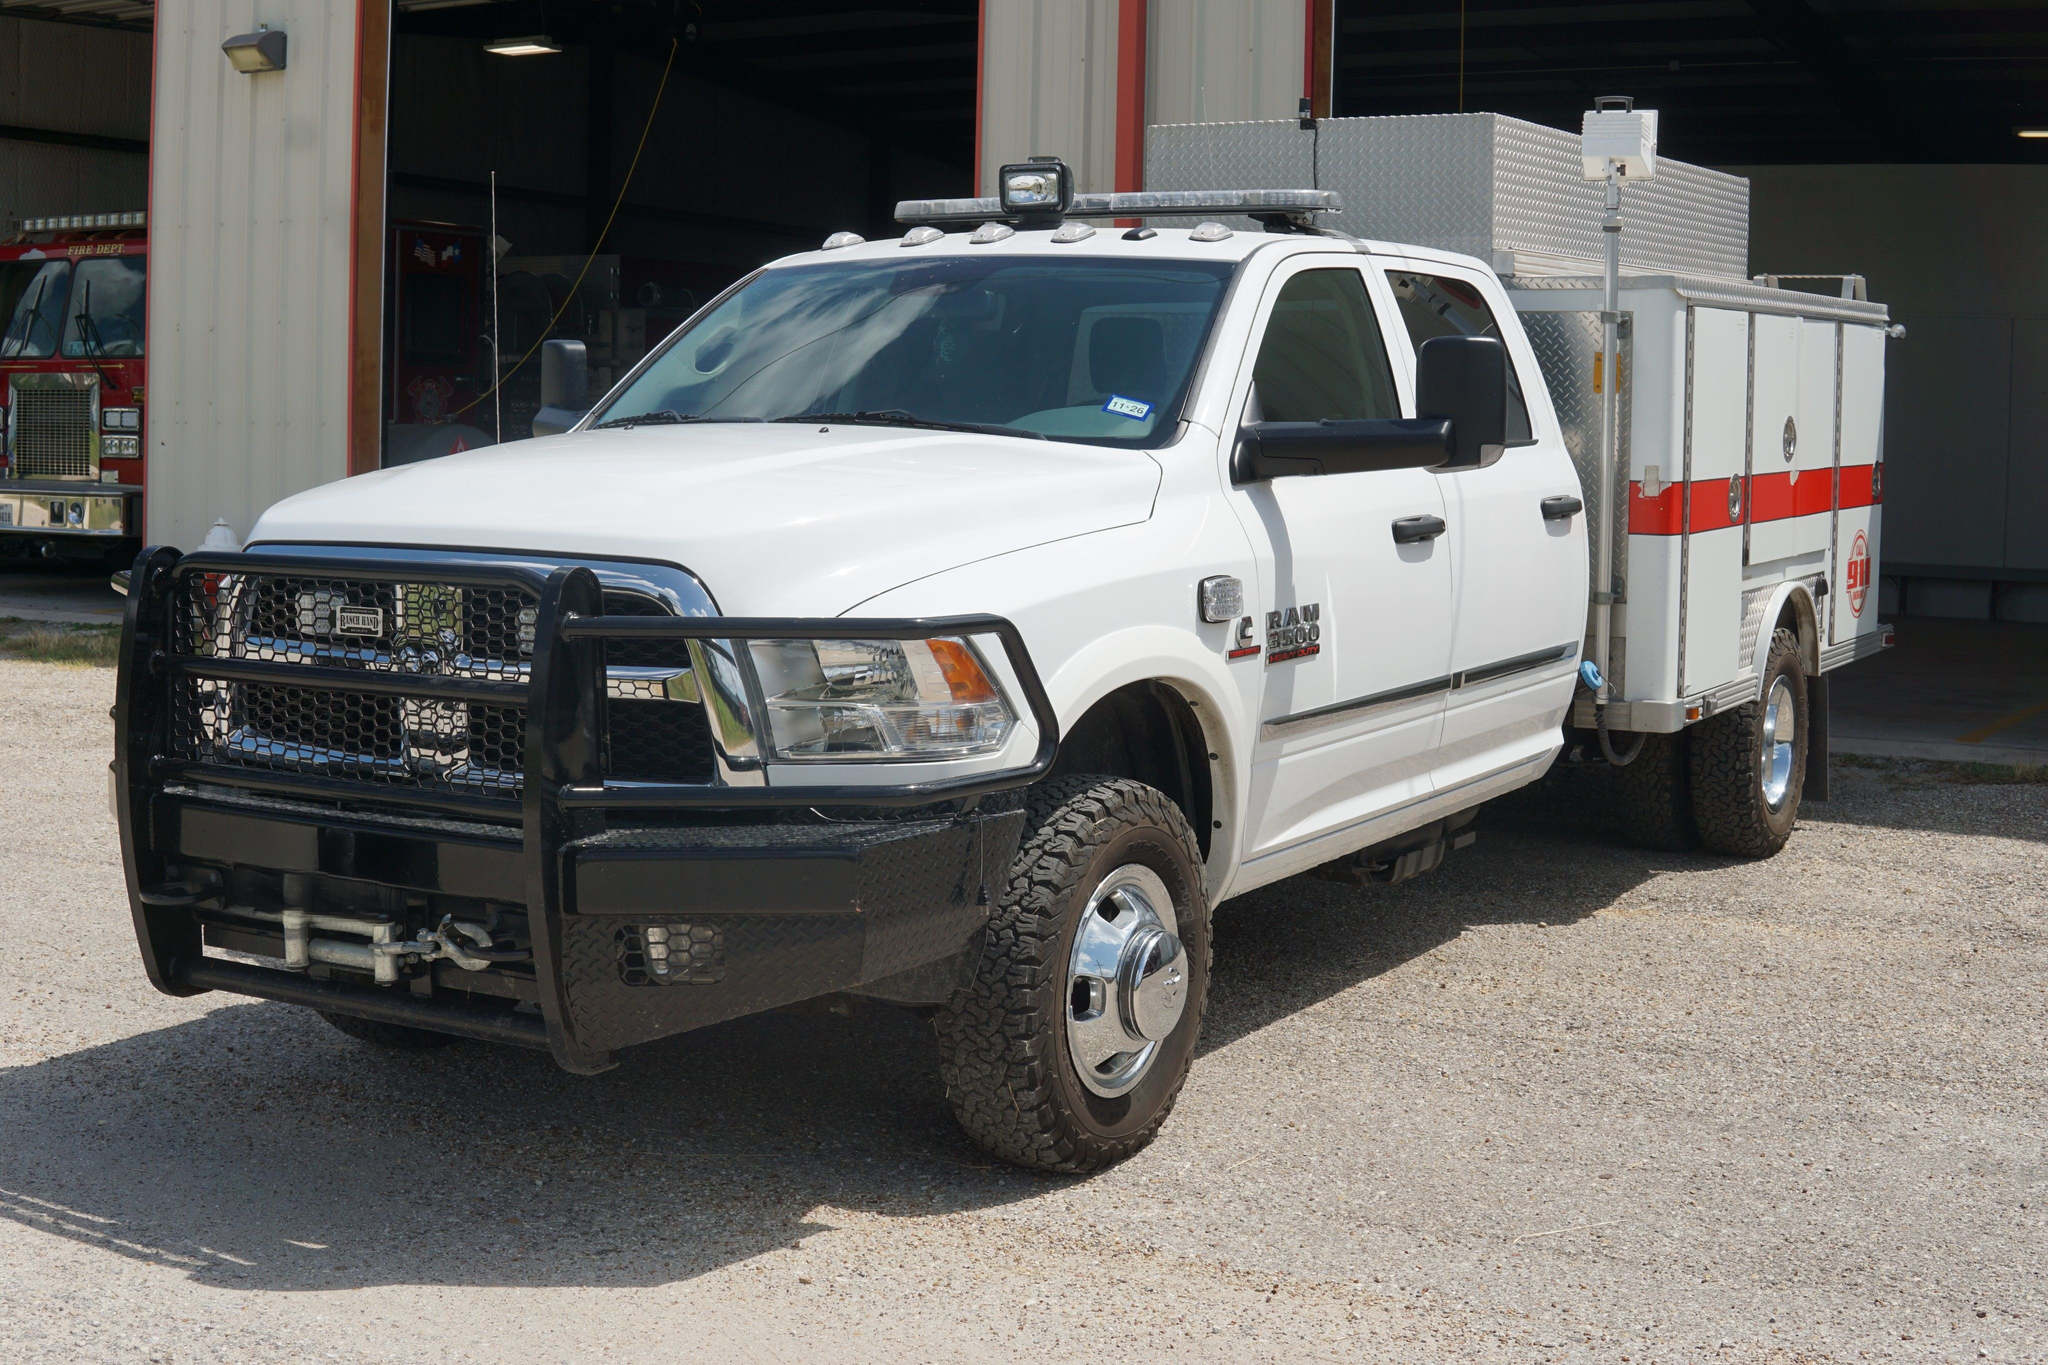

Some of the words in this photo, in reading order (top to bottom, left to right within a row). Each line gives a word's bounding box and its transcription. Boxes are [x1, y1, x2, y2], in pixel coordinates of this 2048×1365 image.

[67, 245, 93, 256] FIRE
[96, 243, 125, 254] DEPT.
[1846, 557, 1871, 590] 911
[340, 614, 360, 627] RANCH
[361, 616, 379, 629] HAND
[1265, 603, 1320, 629] RAM
[1265, 623, 1321, 650] 3500
[1269, 650, 1297, 663] HEAVY
[1297, 645, 1319, 657] DUTY
